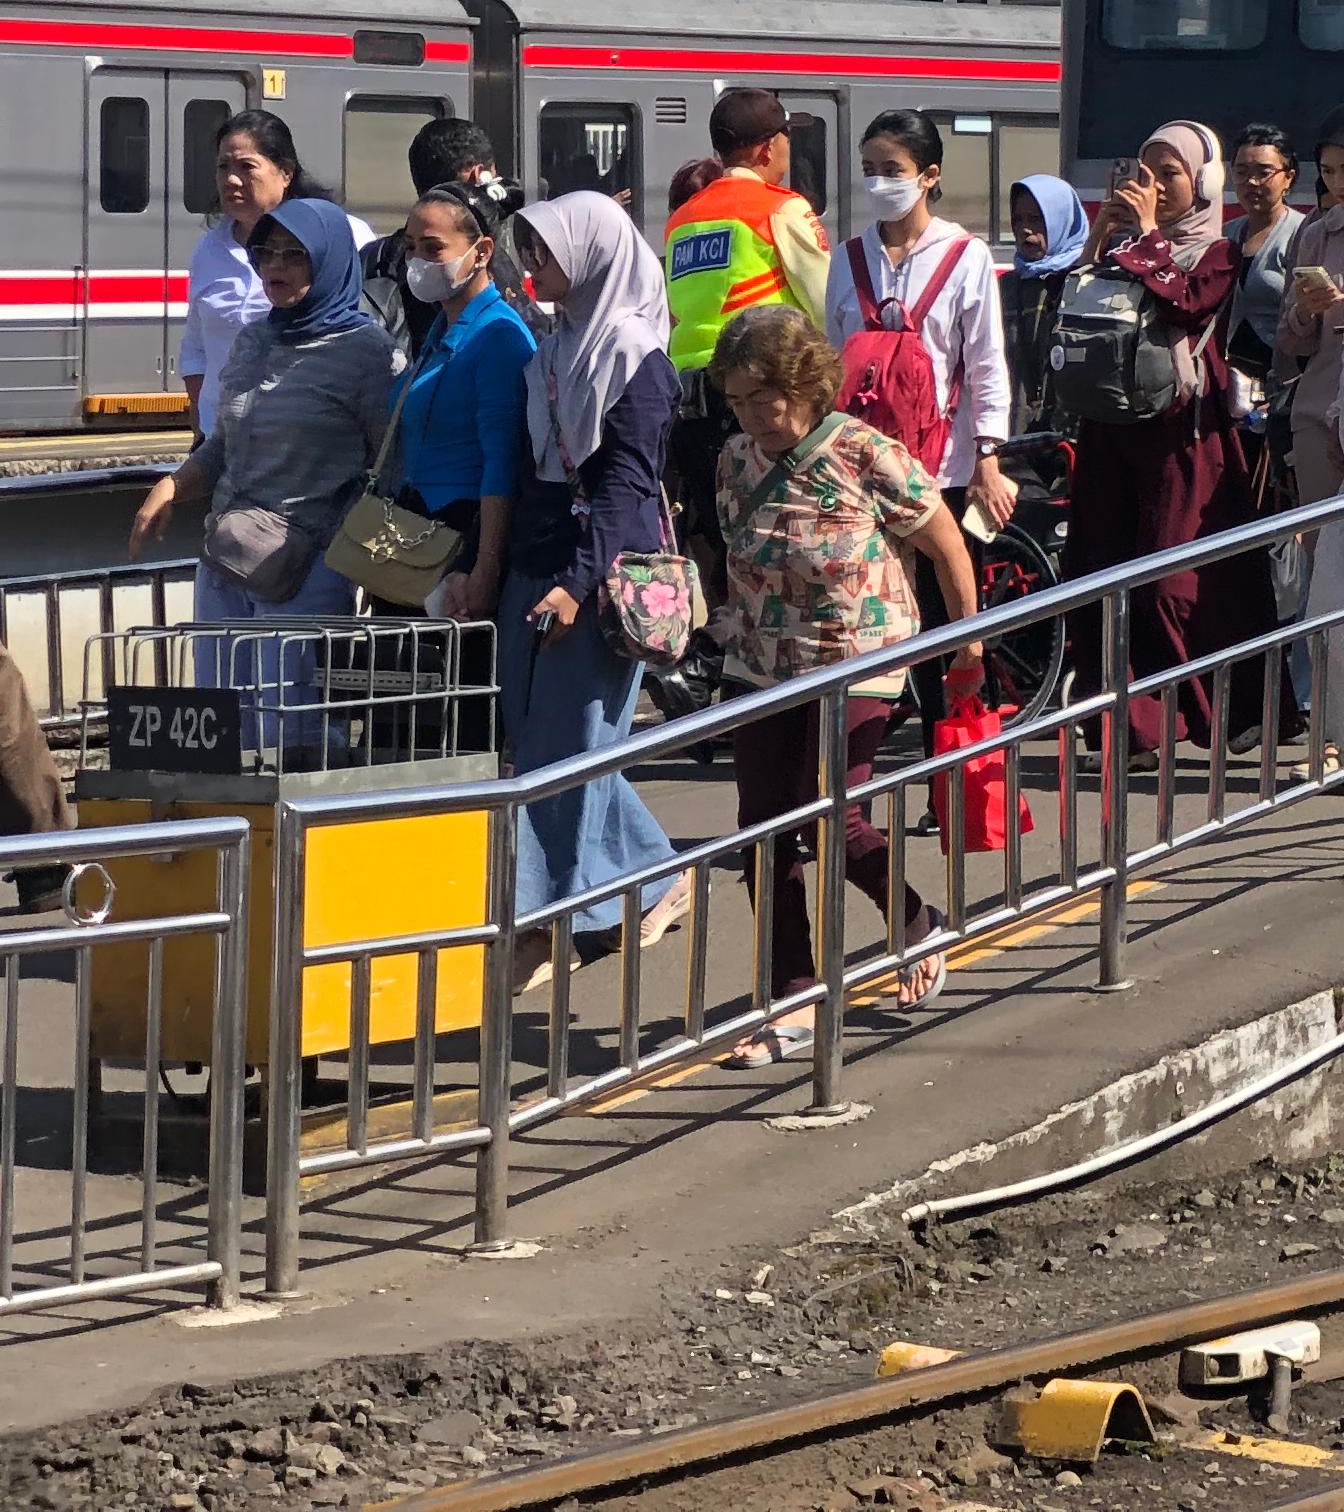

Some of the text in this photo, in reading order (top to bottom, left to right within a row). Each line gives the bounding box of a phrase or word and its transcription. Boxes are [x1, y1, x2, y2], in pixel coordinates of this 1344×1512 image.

[269, 74, 276, 93] 1
[699, 236, 724, 262] KCI
[128, 705, 218, 750] ZP 42C
